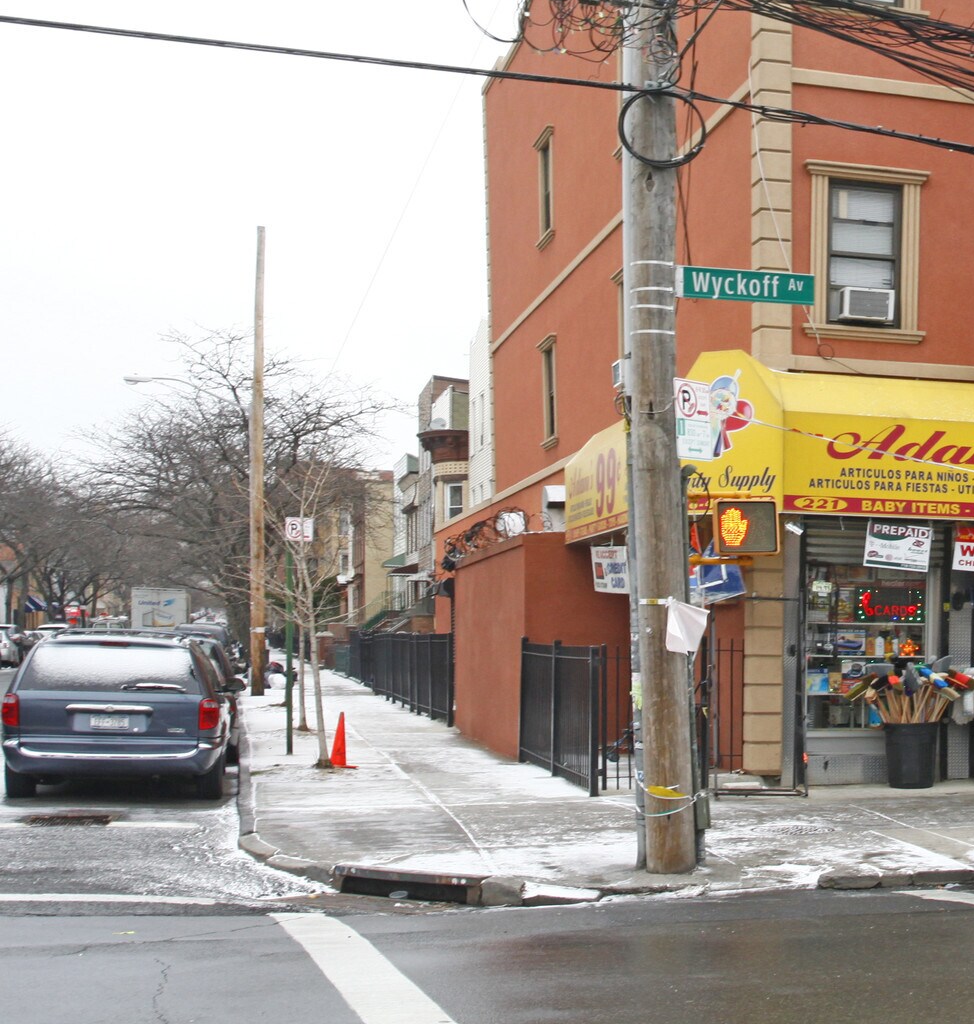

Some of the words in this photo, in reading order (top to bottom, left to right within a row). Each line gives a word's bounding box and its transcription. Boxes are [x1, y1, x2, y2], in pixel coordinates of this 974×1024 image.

[692, 271, 779, 299] Wyckoff
[787, 278, 804, 291] Av
[718, 465, 777, 493] Supply
[840, 467, 902, 480] ARTICULOS
[904, 470, 933, 481] PARA
[809, 478, 871, 490] ARTICULOS
[874, 481, 902, 491] PARA
[906, 482, 948, 493] FIESTAS
[802, 498, 839, 510] 221
[861, 500, 907, 512] BABY
[911, 502, 960, 514] ITEMS
[873, 523, 929, 539] PREPAID
[874, 604, 917, 617] CARDS
